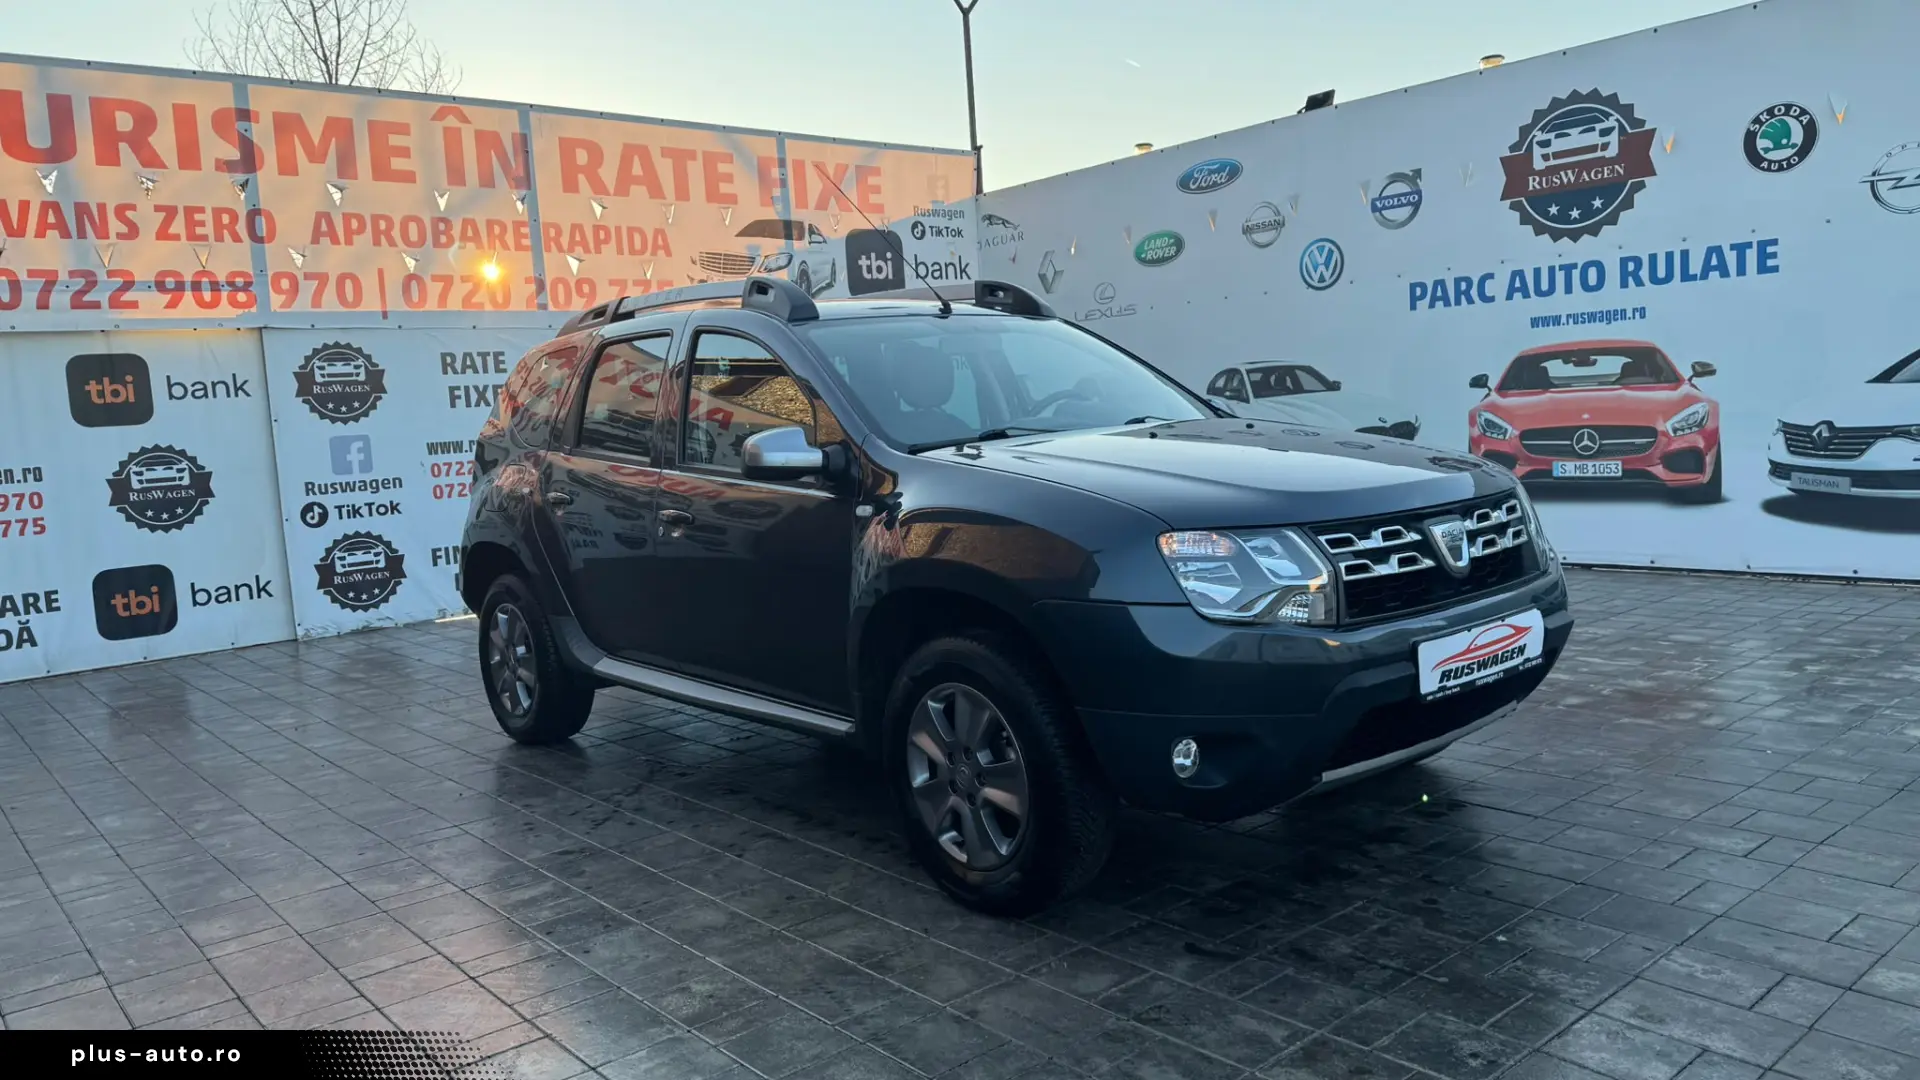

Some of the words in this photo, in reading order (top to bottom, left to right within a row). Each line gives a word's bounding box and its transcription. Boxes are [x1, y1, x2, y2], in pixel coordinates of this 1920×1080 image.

[0, 89, 417, 184] URISME
[430, 105, 531, 191] ÎN
[558, 136, 738, 206] RATE
[758, 155, 885, 214] FIXE
[1760, 156, 1799, 172] AUTO
[1189, 165, 1230, 190] Ford
[1376, 193, 1418, 210] VOLVO
[913, 205, 965, 221] Ruswagen
[0, 199, 140, 240] VANS
[154, 204, 277, 244] ZERO
[311, 210, 530, 253] APROBARE
[543, 219, 672, 258] RAPIDA
[928, 225, 964, 238] TikTok
[1246, 217, 1281, 232] NISSAN
[976, 231, 1024, 250] JAGUAR
[1143, 237, 1169, 251] LAND
[1145, 246, 1176, 261] ROVER
[857, 251, 894, 280] tbi
[914, 253, 972, 281] bank
[1409, 272, 1496, 311] PARC
[1505, 259, 1607, 302] AUTO
[1619, 238, 1780, 289] RULATE
[0, 267, 139, 311] 0722
[154, 269, 258, 311] 908
[270, 271, 364, 310] 970
[525, 275, 597, 311] 209
[1075, 304, 1137, 321] LEXUS
[1530, 306, 1647, 329] www.ruswagen.ro
[440, 351, 508, 375] RATE
[85, 375, 136, 404] tbi
[166, 373, 252, 401] bank
[1591, 461, 1620, 475] 1053
[304, 477, 403, 496] Ruswagen
[1797, 476, 1840, 490] TALISMAN
[0, 491, 43, 512] 970
[334, 501, 402, 520] TikTok
[0, 589, 61, 618] ARE
[111, 586, 161, 617] tbi
[190, 575, 275, 607] bank
[1438, 643, 1527, 684] RUSWAGEN
